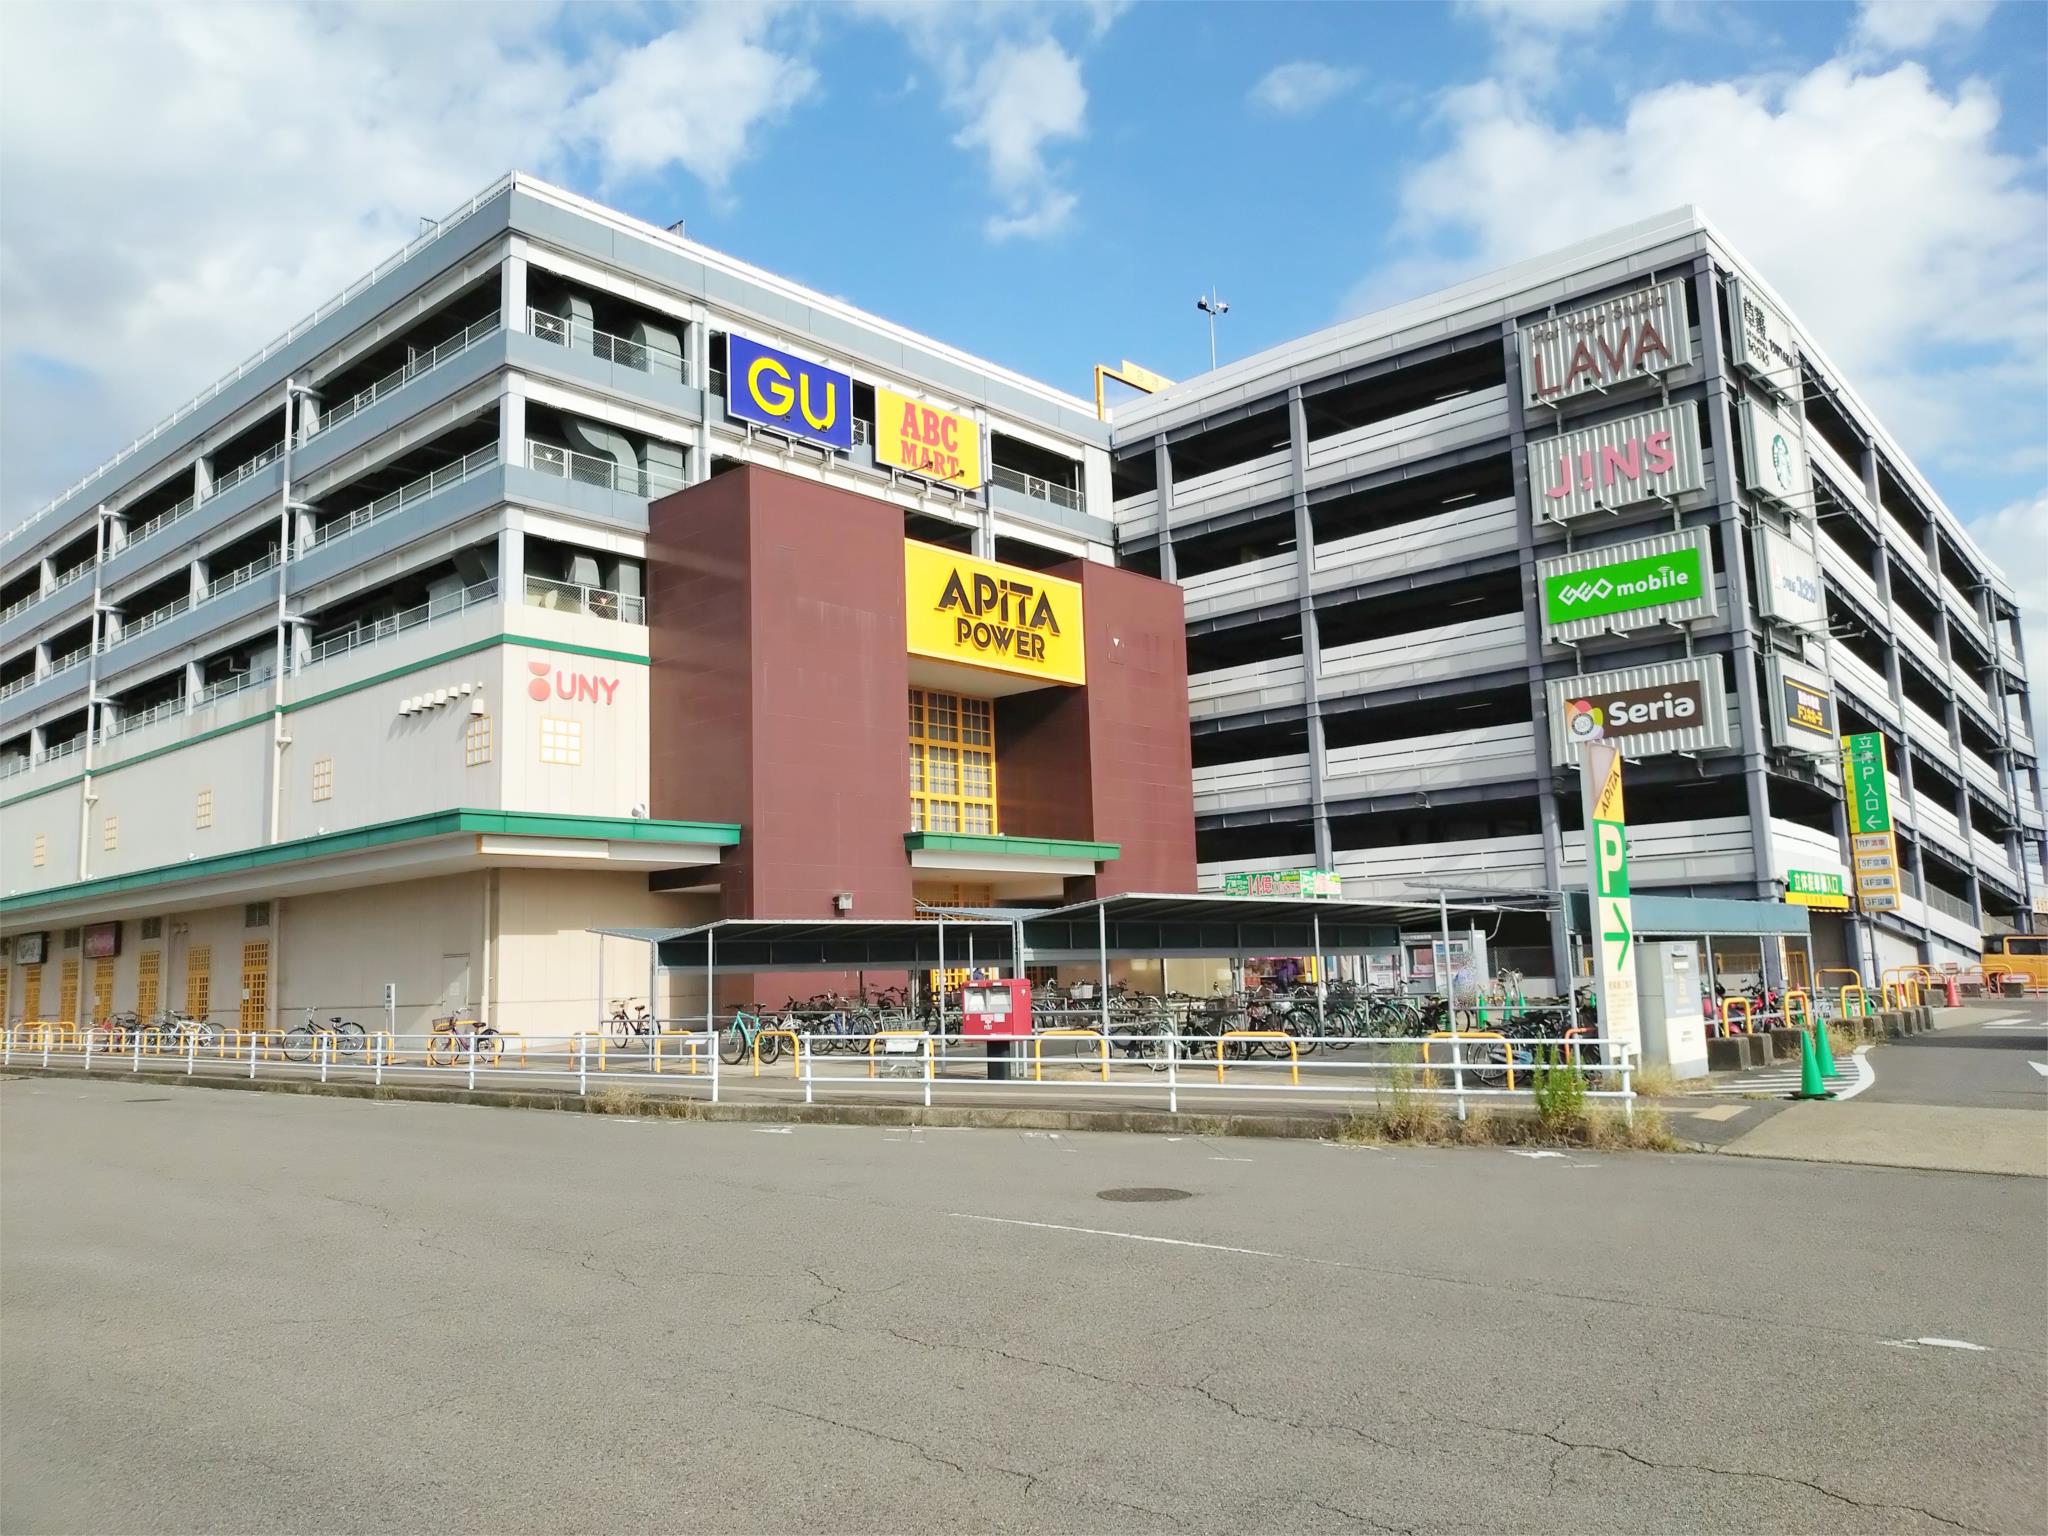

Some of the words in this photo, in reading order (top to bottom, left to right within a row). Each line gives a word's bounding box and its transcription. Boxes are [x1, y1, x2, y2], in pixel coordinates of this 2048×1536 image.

[1565, 315, 1605, 333] Yoga
[1612, 297, 1665, 320] Studio
[1534, 319, 1672, 397] LAVA
[747, 356, 836, 431] GU
[900, 400, 959, 454] ABC
[900, 440, 960, 481] MART
[1558, 577, 1613, 606] GEO
[1616, 566, 1689, 597] mobile
[956, 615, 1046, 662] POWER
[557, 670, 620, 705] UNY
[1608, 691, 1696, 727] Seria
[1598, 823, 1623, 894] P
